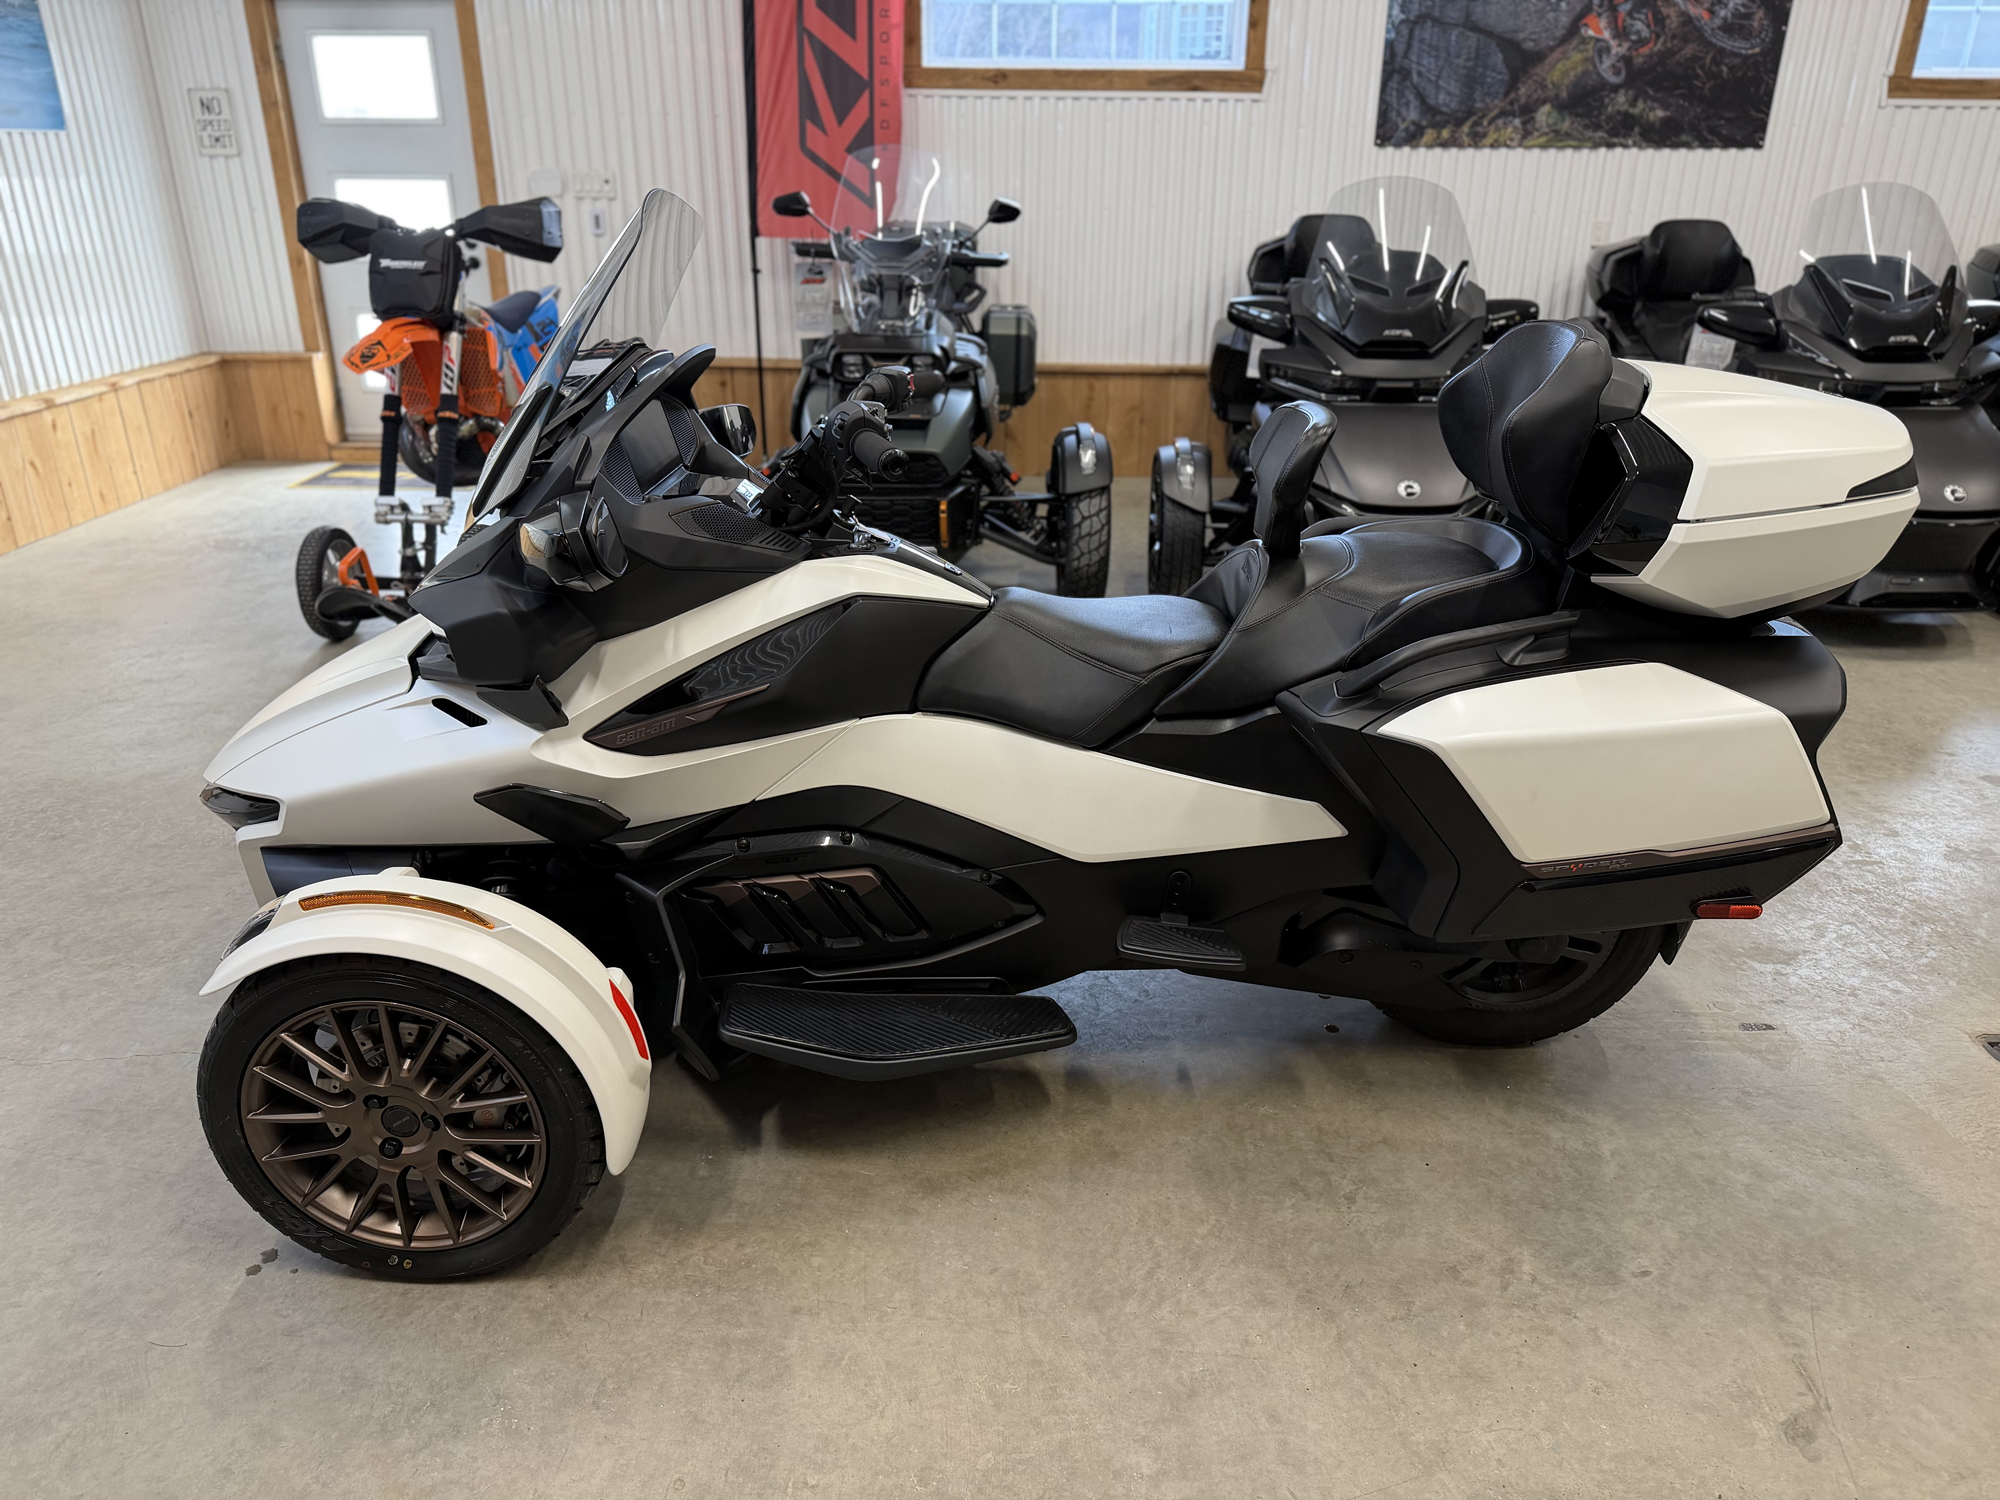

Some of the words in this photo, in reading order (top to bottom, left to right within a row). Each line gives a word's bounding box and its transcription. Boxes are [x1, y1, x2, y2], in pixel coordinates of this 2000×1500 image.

[199, 96, 222, 116] NO
[199, 134, 234, 149] LIMIT
[616, 717, 677, 745] can-am
[765, 856, 799, 866] ROTAX
[1540, 859, 1627, 873] SPYDER
